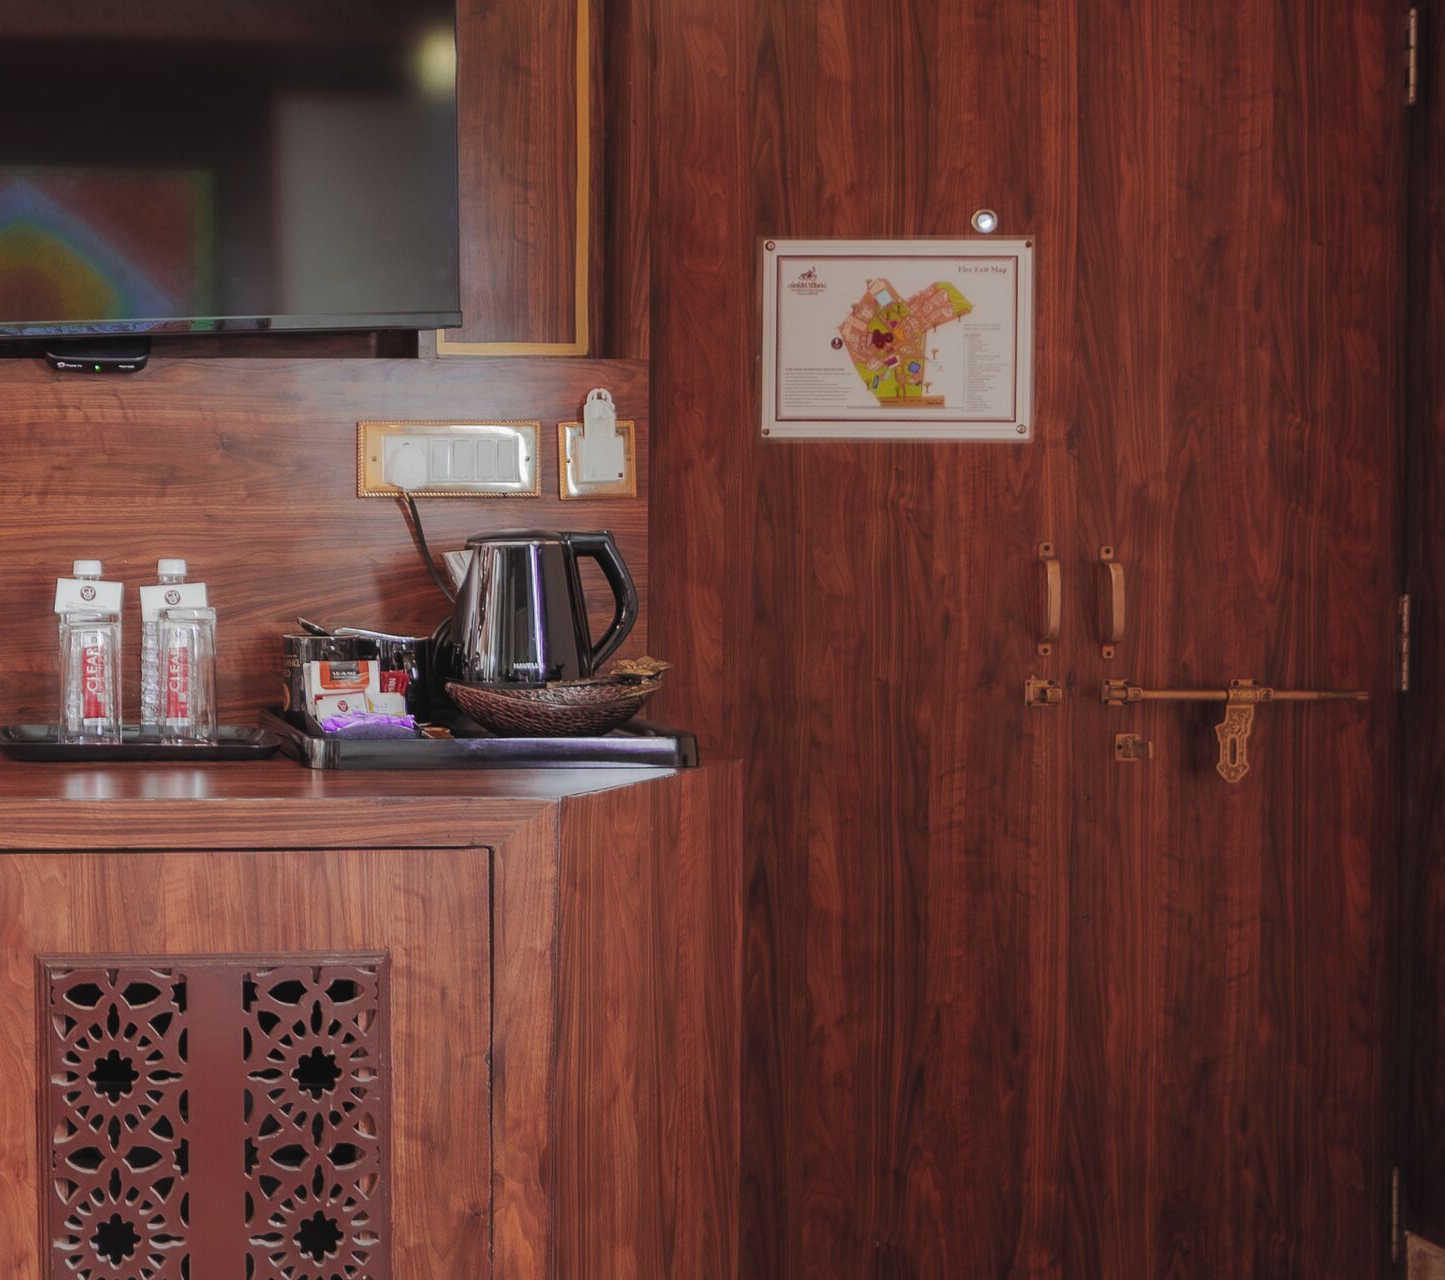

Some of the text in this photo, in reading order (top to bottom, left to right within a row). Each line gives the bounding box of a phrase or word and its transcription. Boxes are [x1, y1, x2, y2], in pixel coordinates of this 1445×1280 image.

[990, 265, 1008, 275] Map
[86, 646, 99, 693] CLEAR
[513, 662, 543, 670] HAVELL
